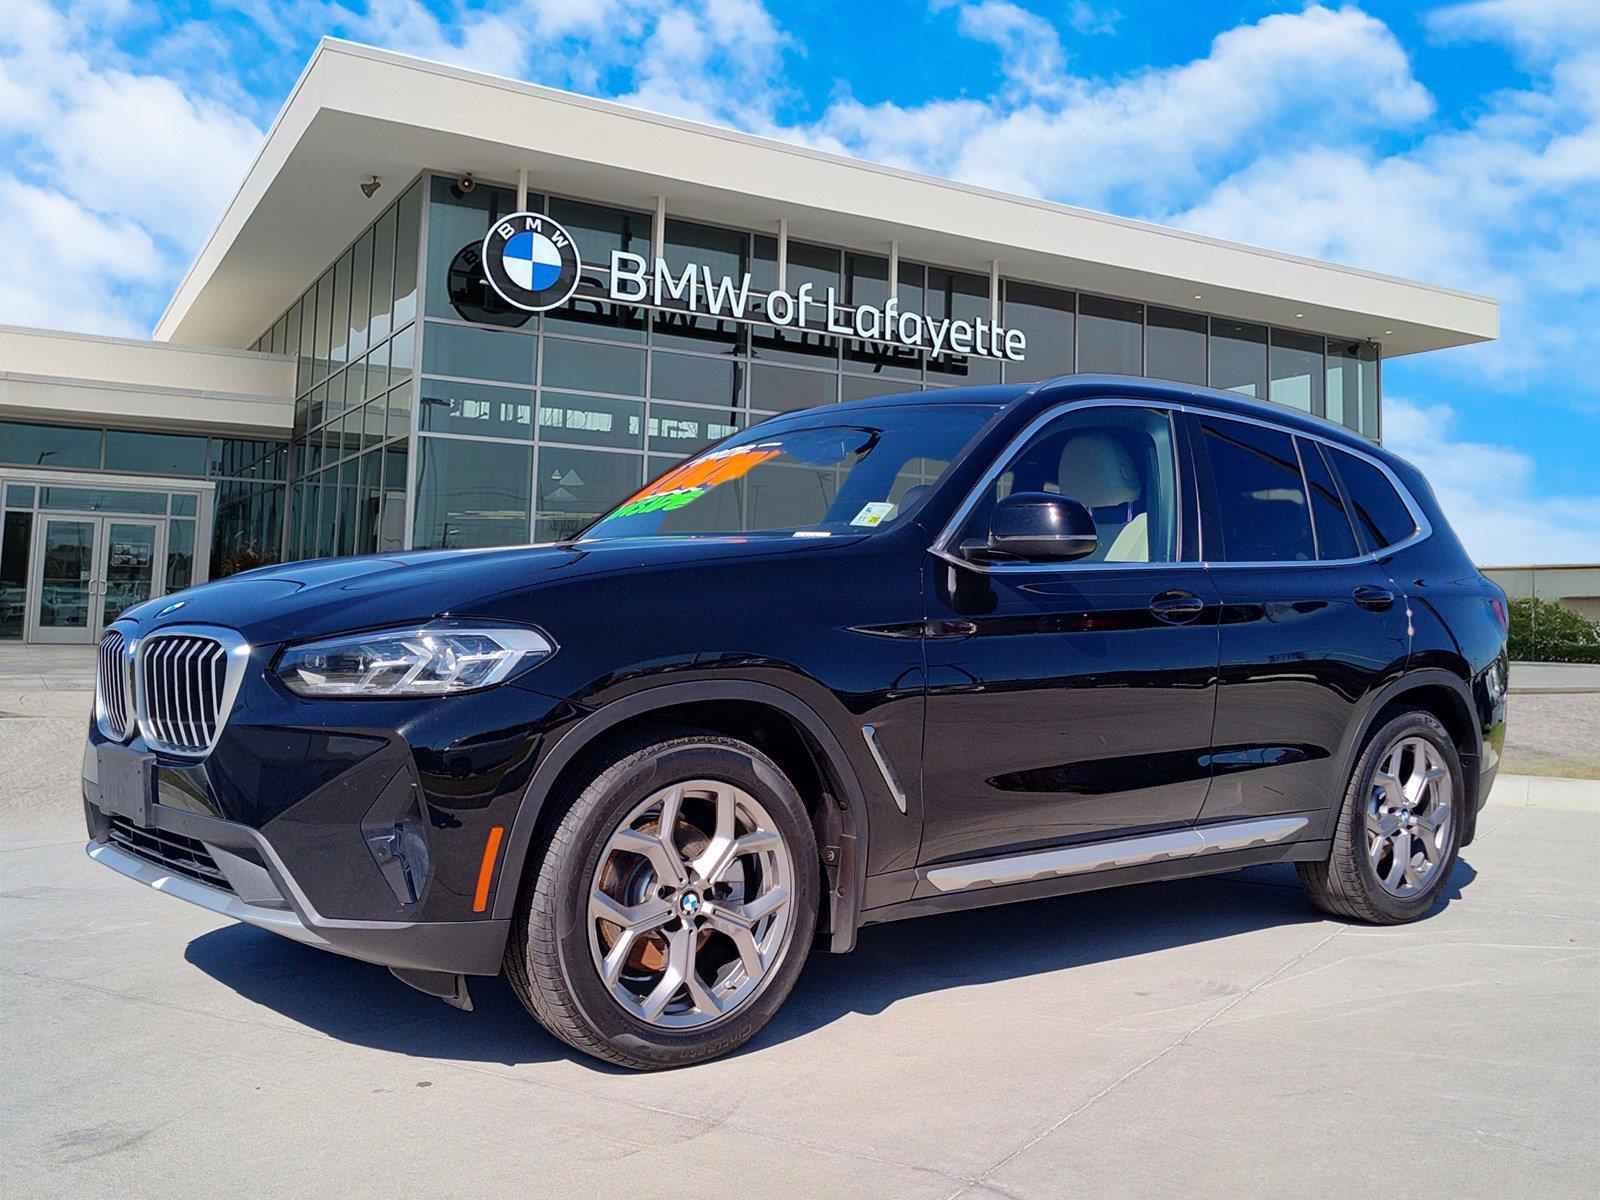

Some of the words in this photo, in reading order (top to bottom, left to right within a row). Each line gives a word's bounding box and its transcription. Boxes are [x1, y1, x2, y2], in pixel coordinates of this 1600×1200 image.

[497, 217, 569, 248] BMW
[610, 250, 751, 318] BMW
[767, 282, 813, 327] of
[827, 287, 1026, 361] Lafayette
